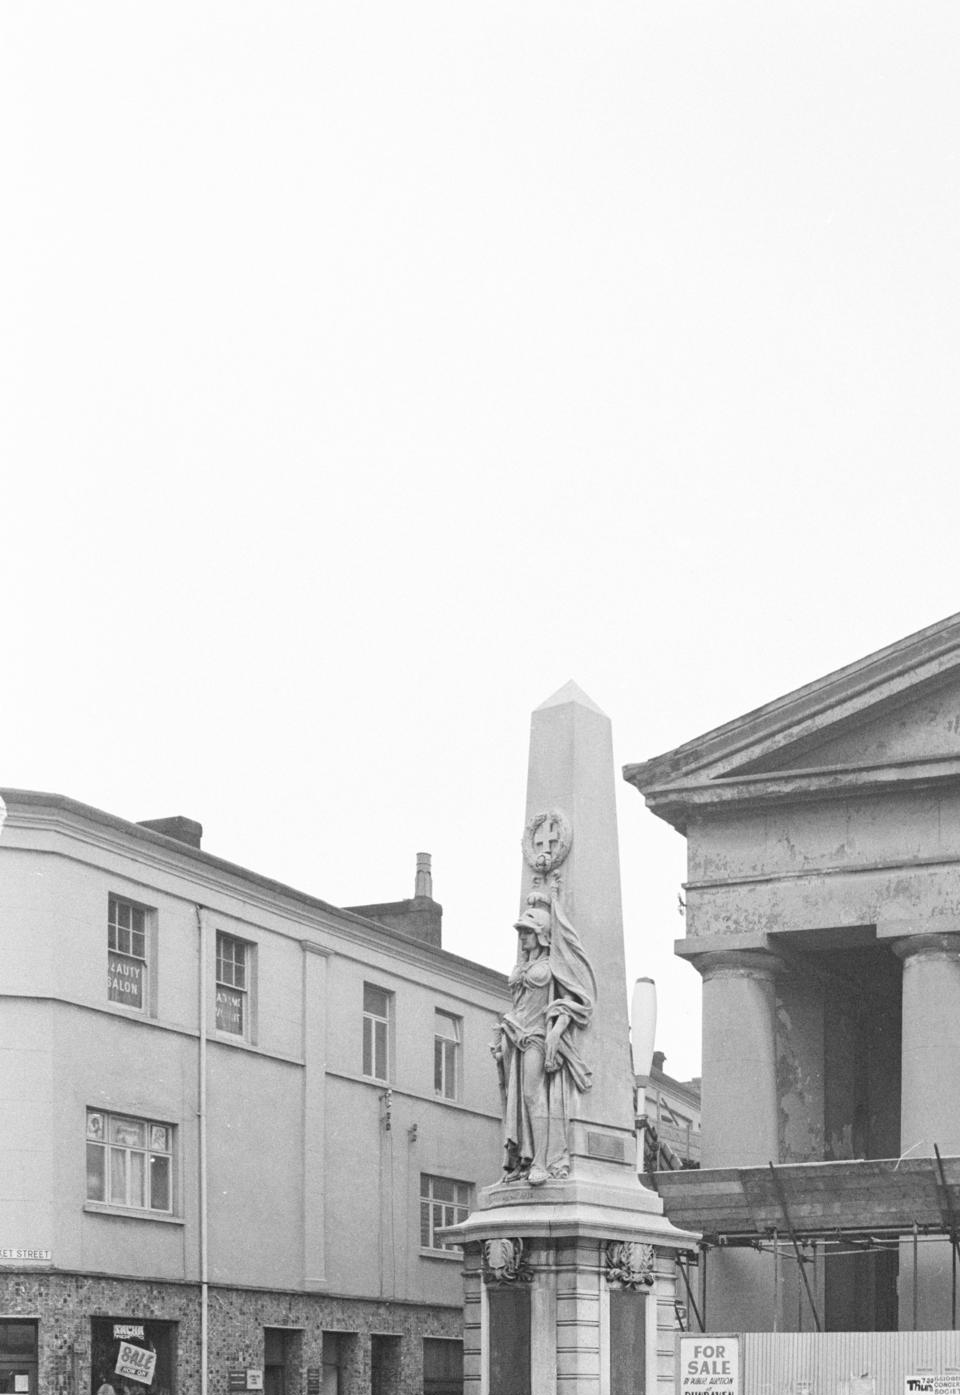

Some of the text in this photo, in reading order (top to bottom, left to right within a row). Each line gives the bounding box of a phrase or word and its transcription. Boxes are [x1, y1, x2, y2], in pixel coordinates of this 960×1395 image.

[16, 1249, 49, 1259] STREET
[121, 1346, 154, 1370] SALE
[694, 1345, 725, 1358] FOR
[687, 1360, 731, 1375] SALE
[709, 1377, 734, 1385] AUCTION
